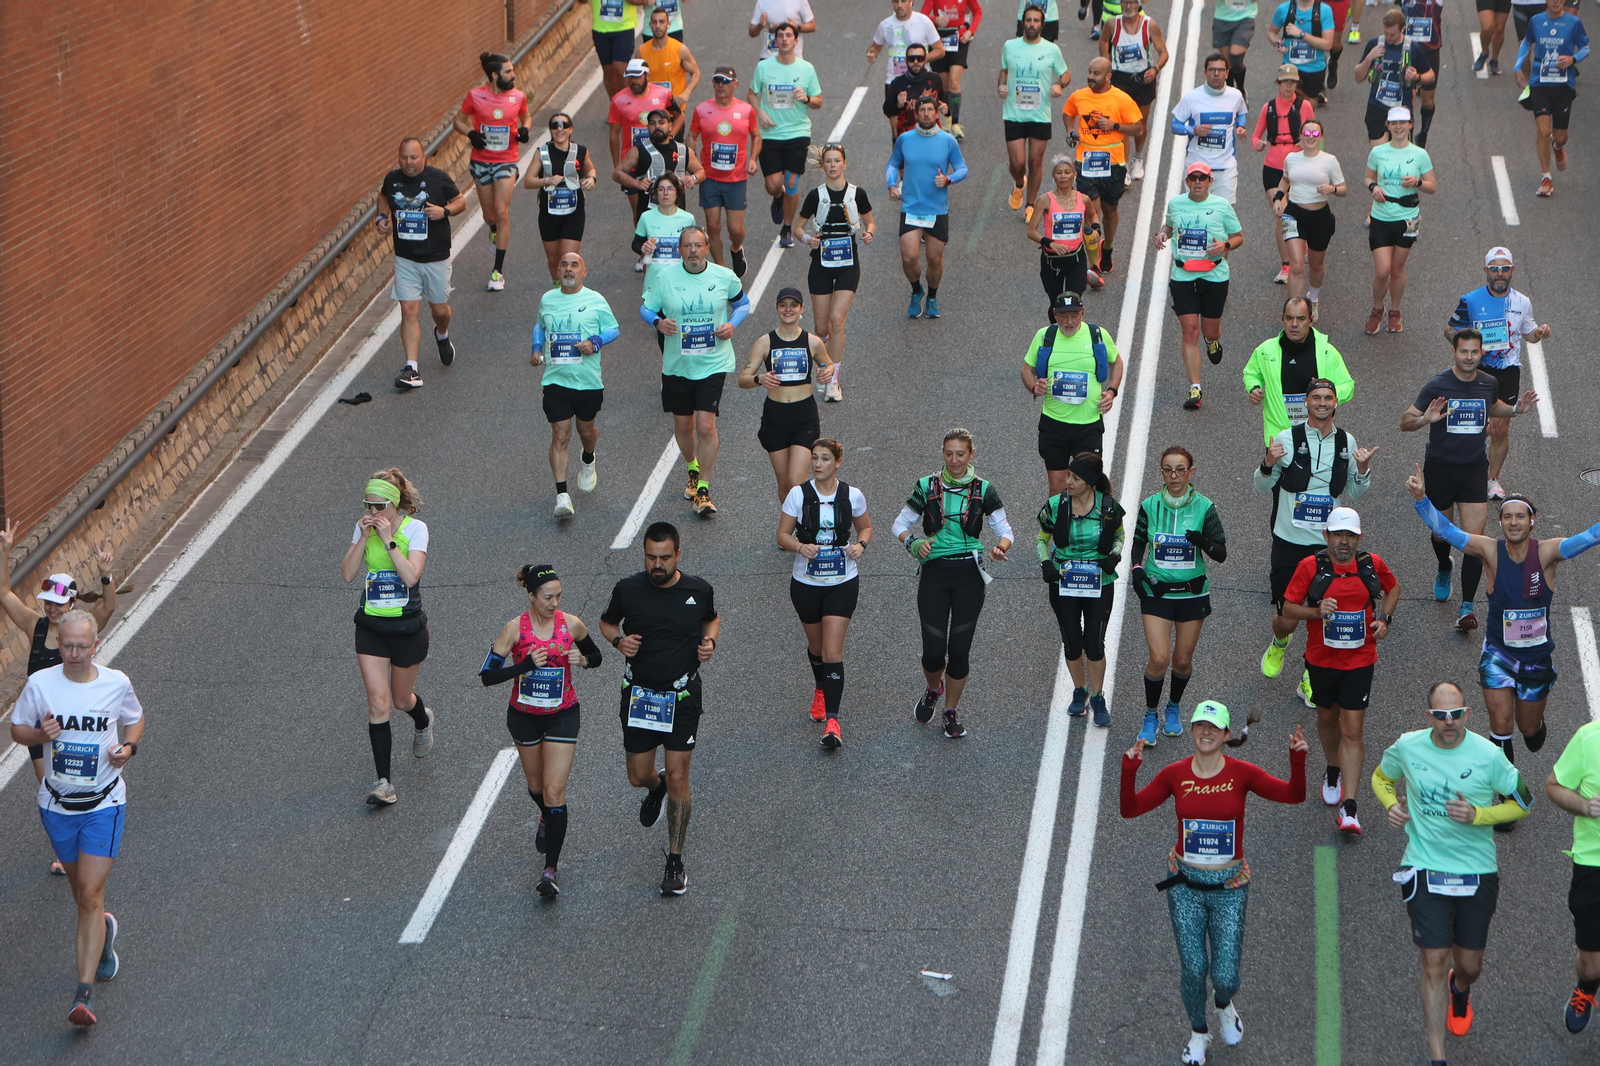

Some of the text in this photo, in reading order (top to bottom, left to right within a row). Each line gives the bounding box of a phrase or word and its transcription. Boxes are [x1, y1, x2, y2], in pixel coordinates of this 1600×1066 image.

[820, 549, 842, 557] ZURICH
[532, 682, 550, 690] 11412
[646, 692, 670, 700] ZURICH
[50, 714, 109, 732] MARK
[67, 745, 94, 753] ZURICH
[64, 758, 84, 768] 12333
[65, 768, 82, 776] MARK
[1180, 778, 1234, 798] Franci
[1422, 809, 1448, 817] SEVILL
[1201, 822, 1228, 831] ZURICH
[1198, 837, 1219, 846] 11974
[1198, 847, 1219, 855] FRANCI
